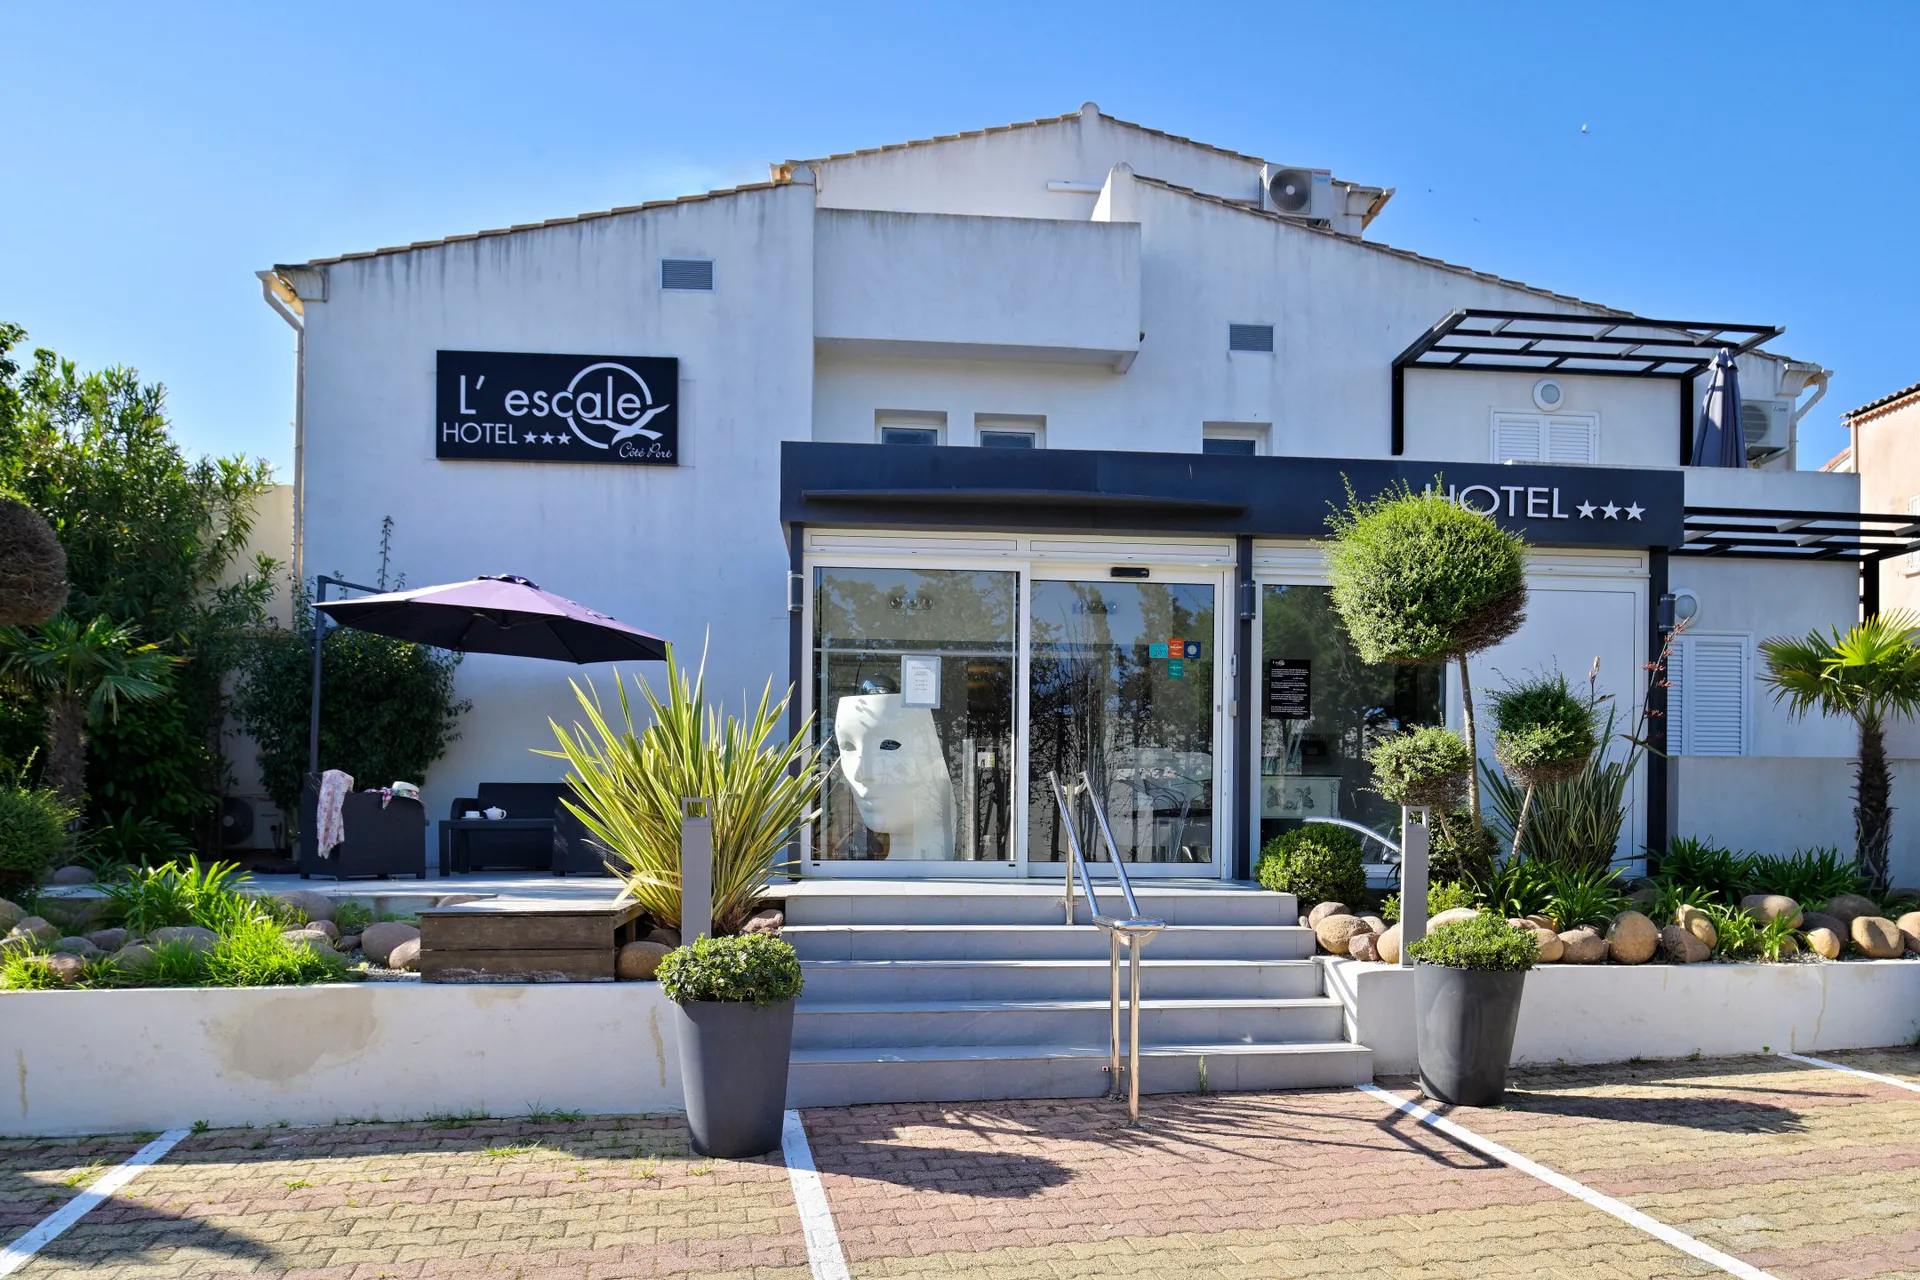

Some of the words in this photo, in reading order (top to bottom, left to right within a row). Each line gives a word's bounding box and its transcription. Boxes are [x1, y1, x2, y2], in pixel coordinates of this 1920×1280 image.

[505, 376, 641, 419] escale
[443, 422, 518, 444] HOTEL
[646, 443, 673, 458] Port
[1425, 483, 1569, 518] HOTEL
